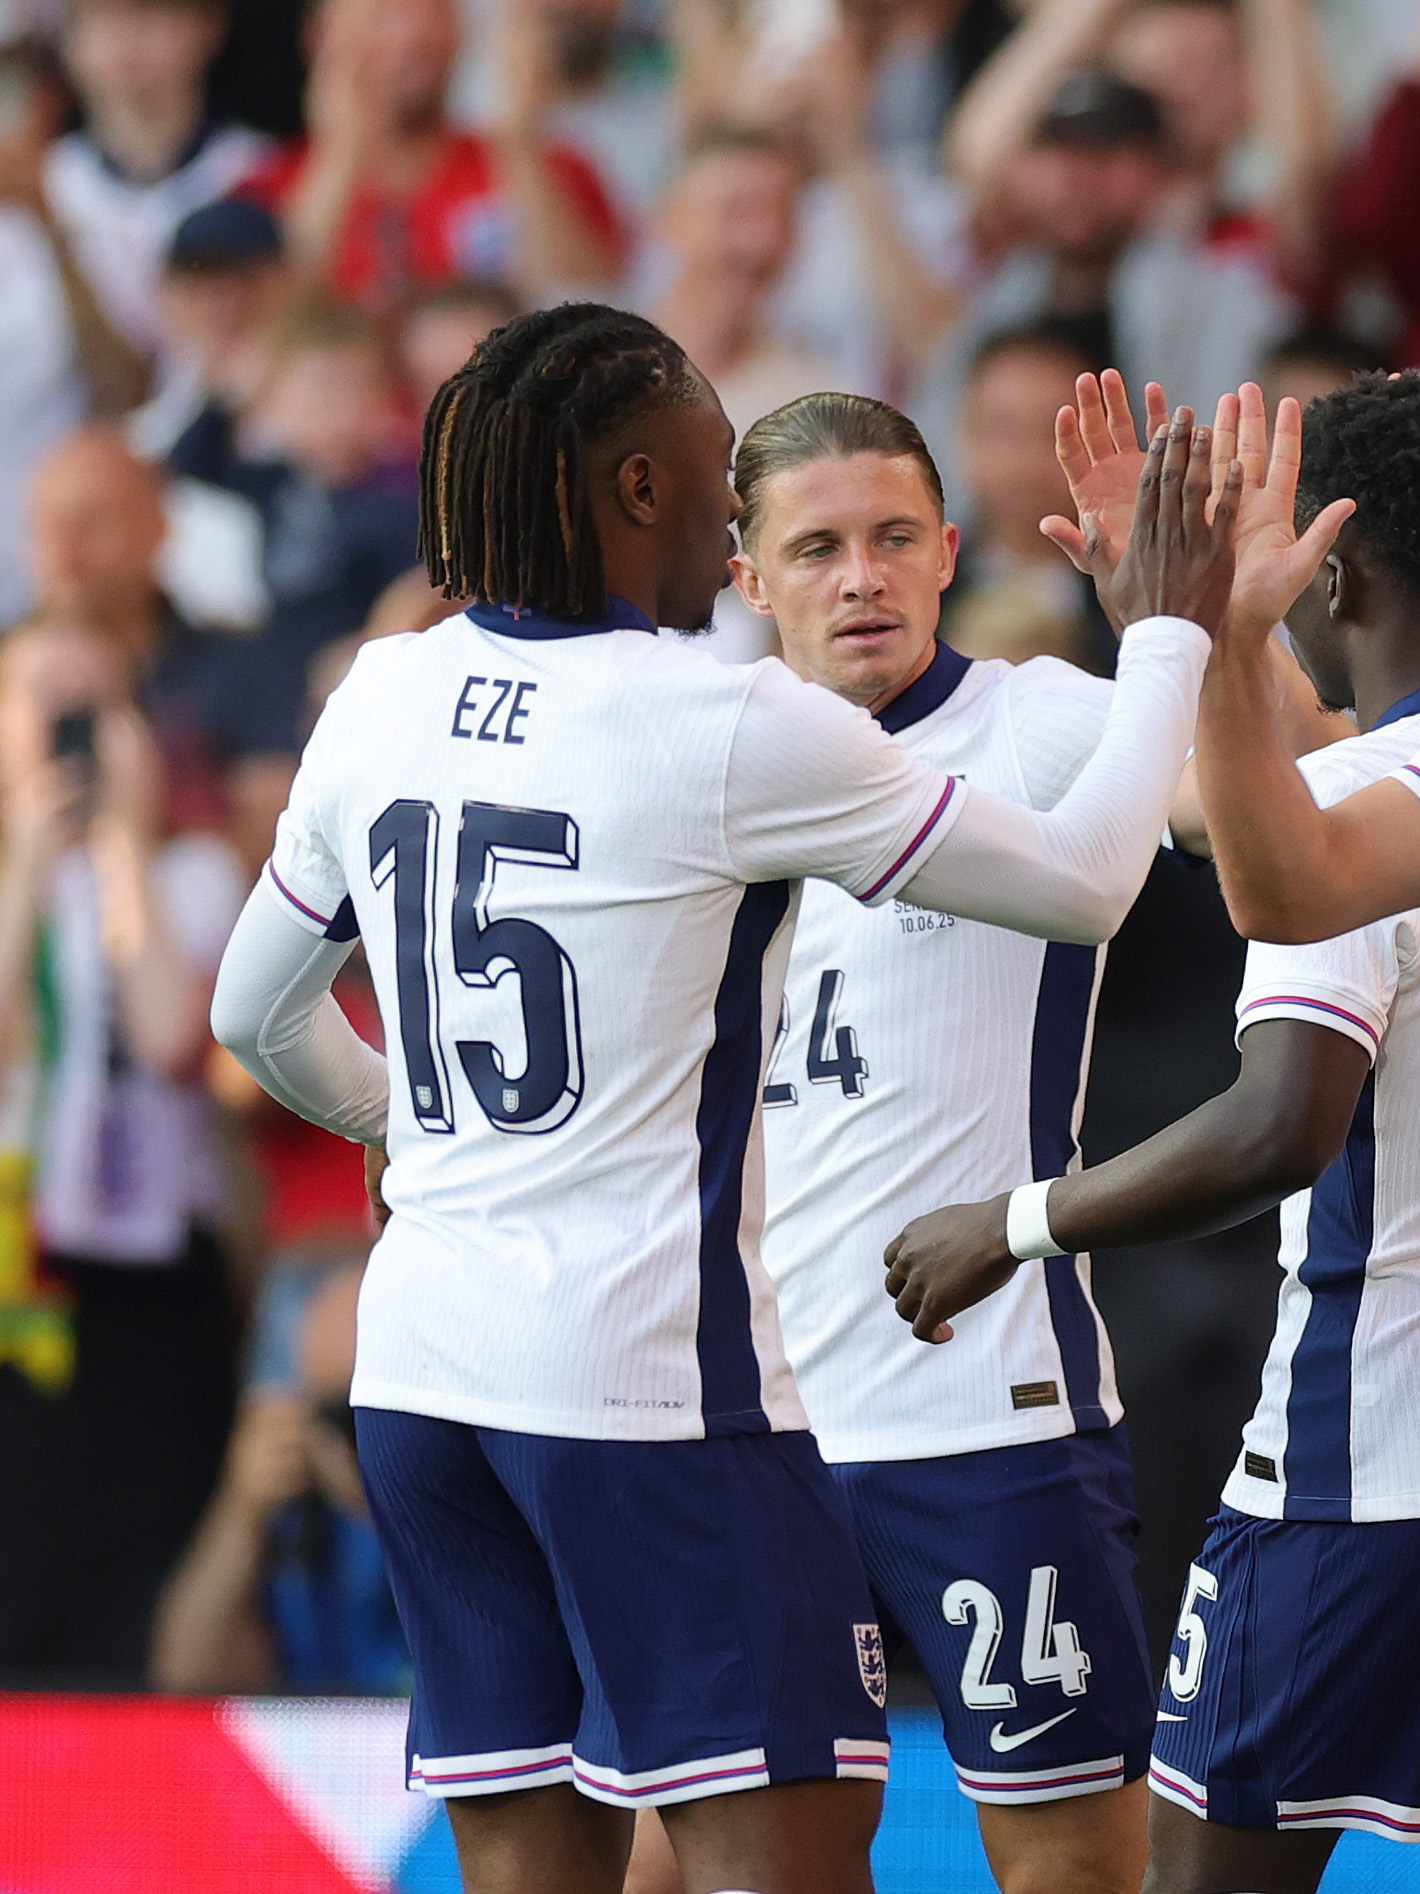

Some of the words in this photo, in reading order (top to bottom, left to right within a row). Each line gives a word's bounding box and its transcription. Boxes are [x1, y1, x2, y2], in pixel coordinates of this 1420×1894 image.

[451, 676, 538, 745] EZE
[368, 798, 586, 1134] 15
[900, 913, 955, 934] 10.06.25
[942, 1565, 1092, 1710] 24
